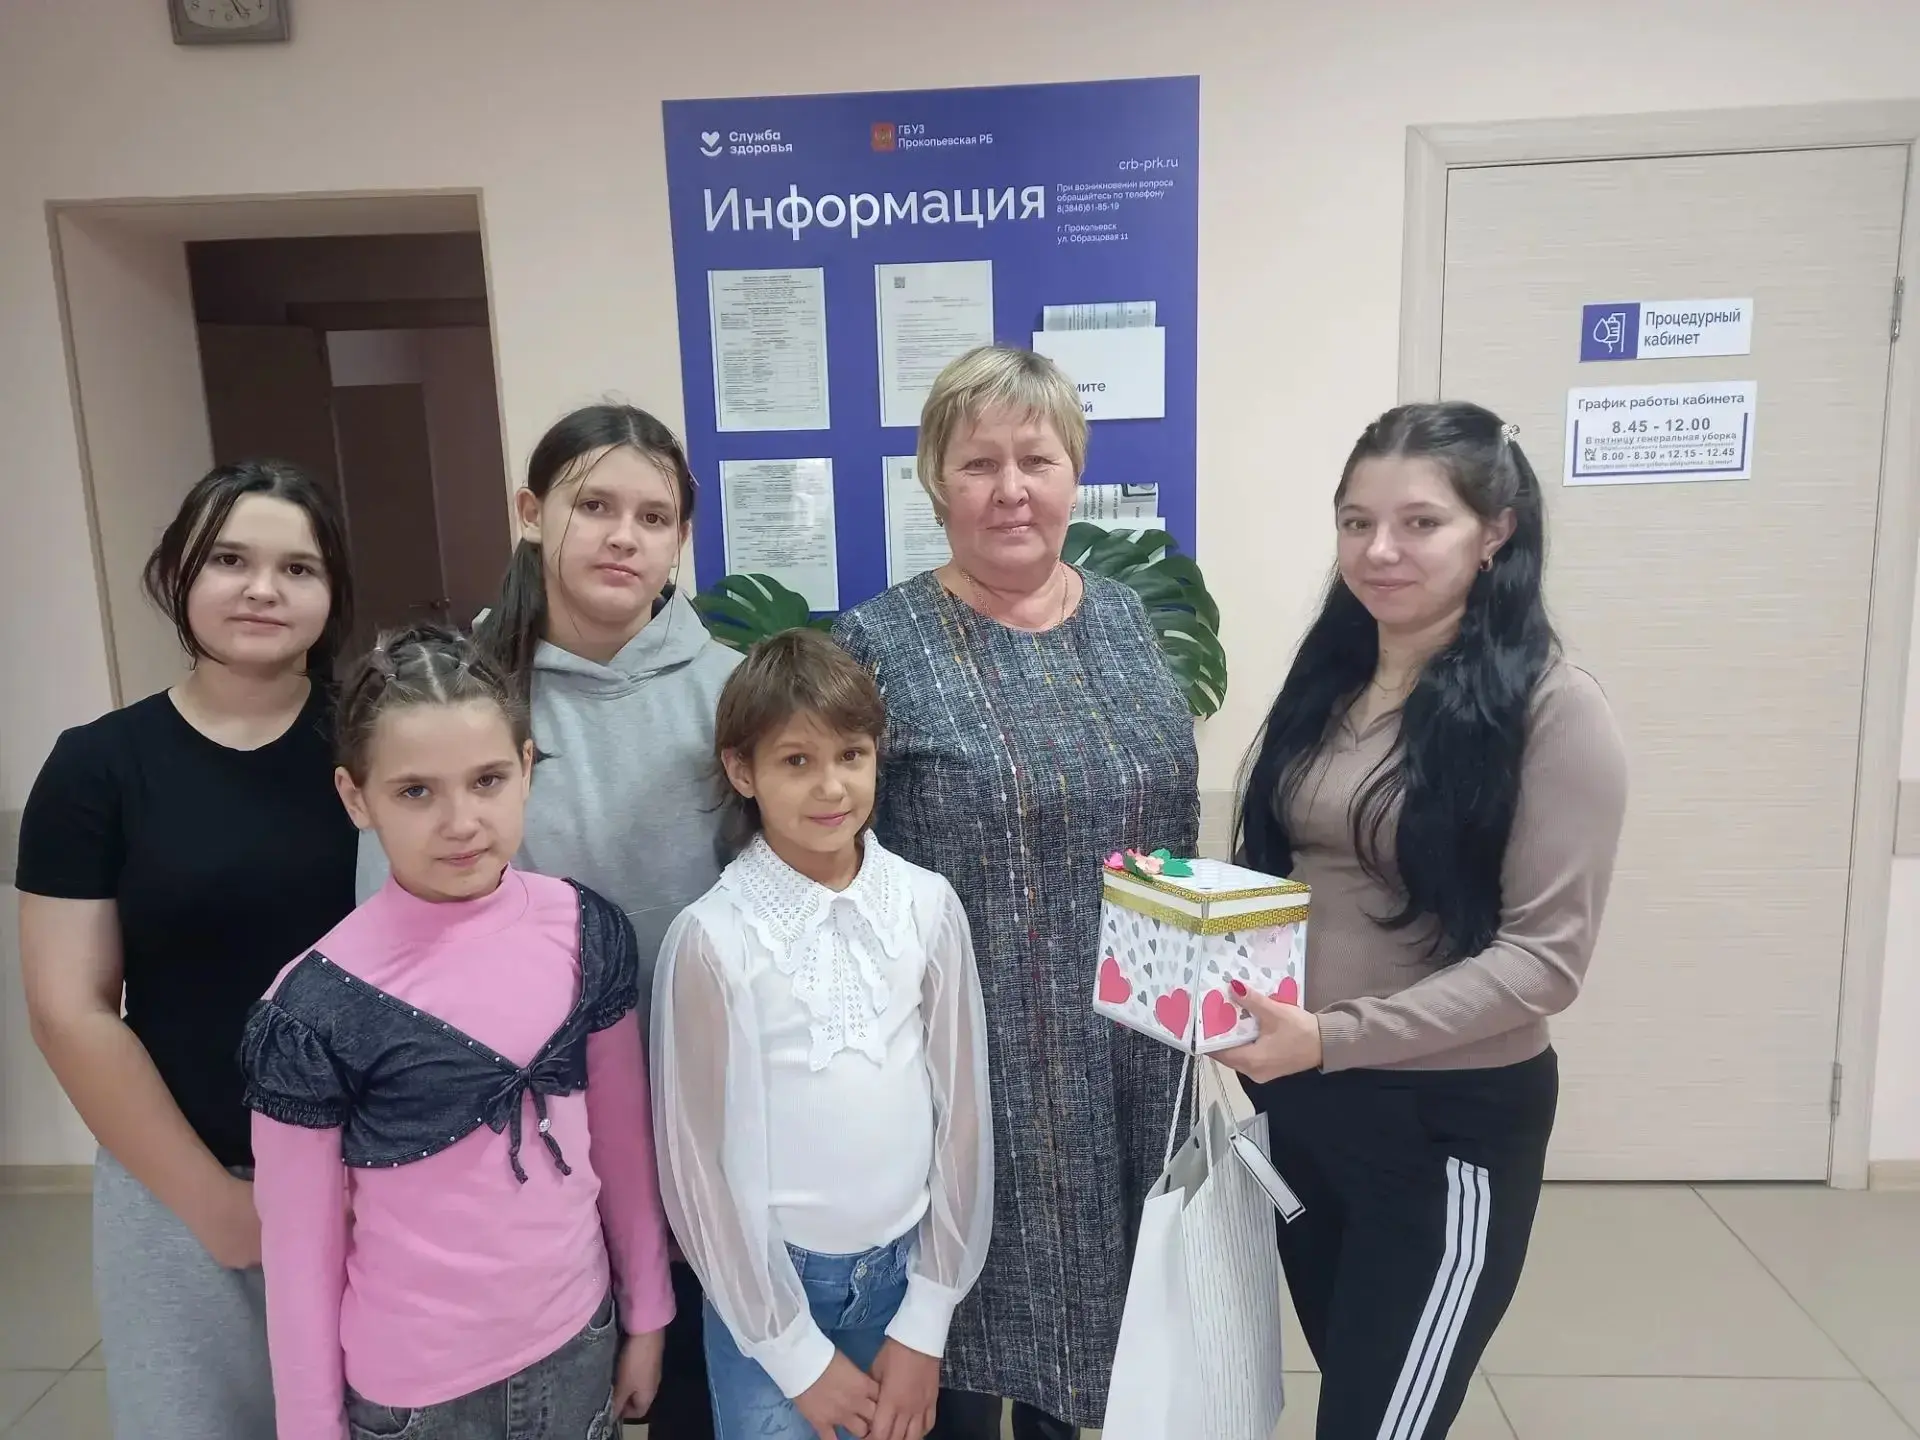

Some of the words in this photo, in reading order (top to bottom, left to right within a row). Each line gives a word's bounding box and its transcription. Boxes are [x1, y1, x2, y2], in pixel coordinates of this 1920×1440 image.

[729, 129, 781, 143] Служба
[898, 125, 925, 135] ГБУЗ
[898, 136, 977, 150] Прокопьевская
[979, 134, 993, 144] РБ
[729, 143, 793, 157] здоровья
[1118, 156, 1179, 171] crb-prk.ru
[1056, 183, 1073, 193] При
[1074, 181, 1138, 191] возникновении
[1139, 179, 1174, 189] вопроса
[1056, 192, 1112, 203] обращайтесь
[1125, 190, 1165, 200] телефону
[703, 184, 1046, 241] Информация
[1069, 234, 1119, 245] Образцовая
[1120, 233, 1129, 241] 11
[1645, 308, 1741, 329] Процедурный
[1644, 331, 1700, 347] кабинет
[1578, 397, 1626, 412] График
[1629, 395, 1679, 410] работы
[1682, 393, 1745, 407] кабинета
[1612, 420, 1648, 434] 8.45
[1665, 417, 1711, 432] 12.00
[1585, 437, 1592, 445] В
[1594, 436, 1635, 446] пятницу
[1637, 434, 1700, 443] генеральная
[1701, 432, 1737, 443] уборка
[1601, 452, 1624, 461] 8.00
[1634, 451, 1656, 460] 8.30
[1667, 449, 1696, 459] 12.15
[1707, 447, 1735, 457] 12.45
